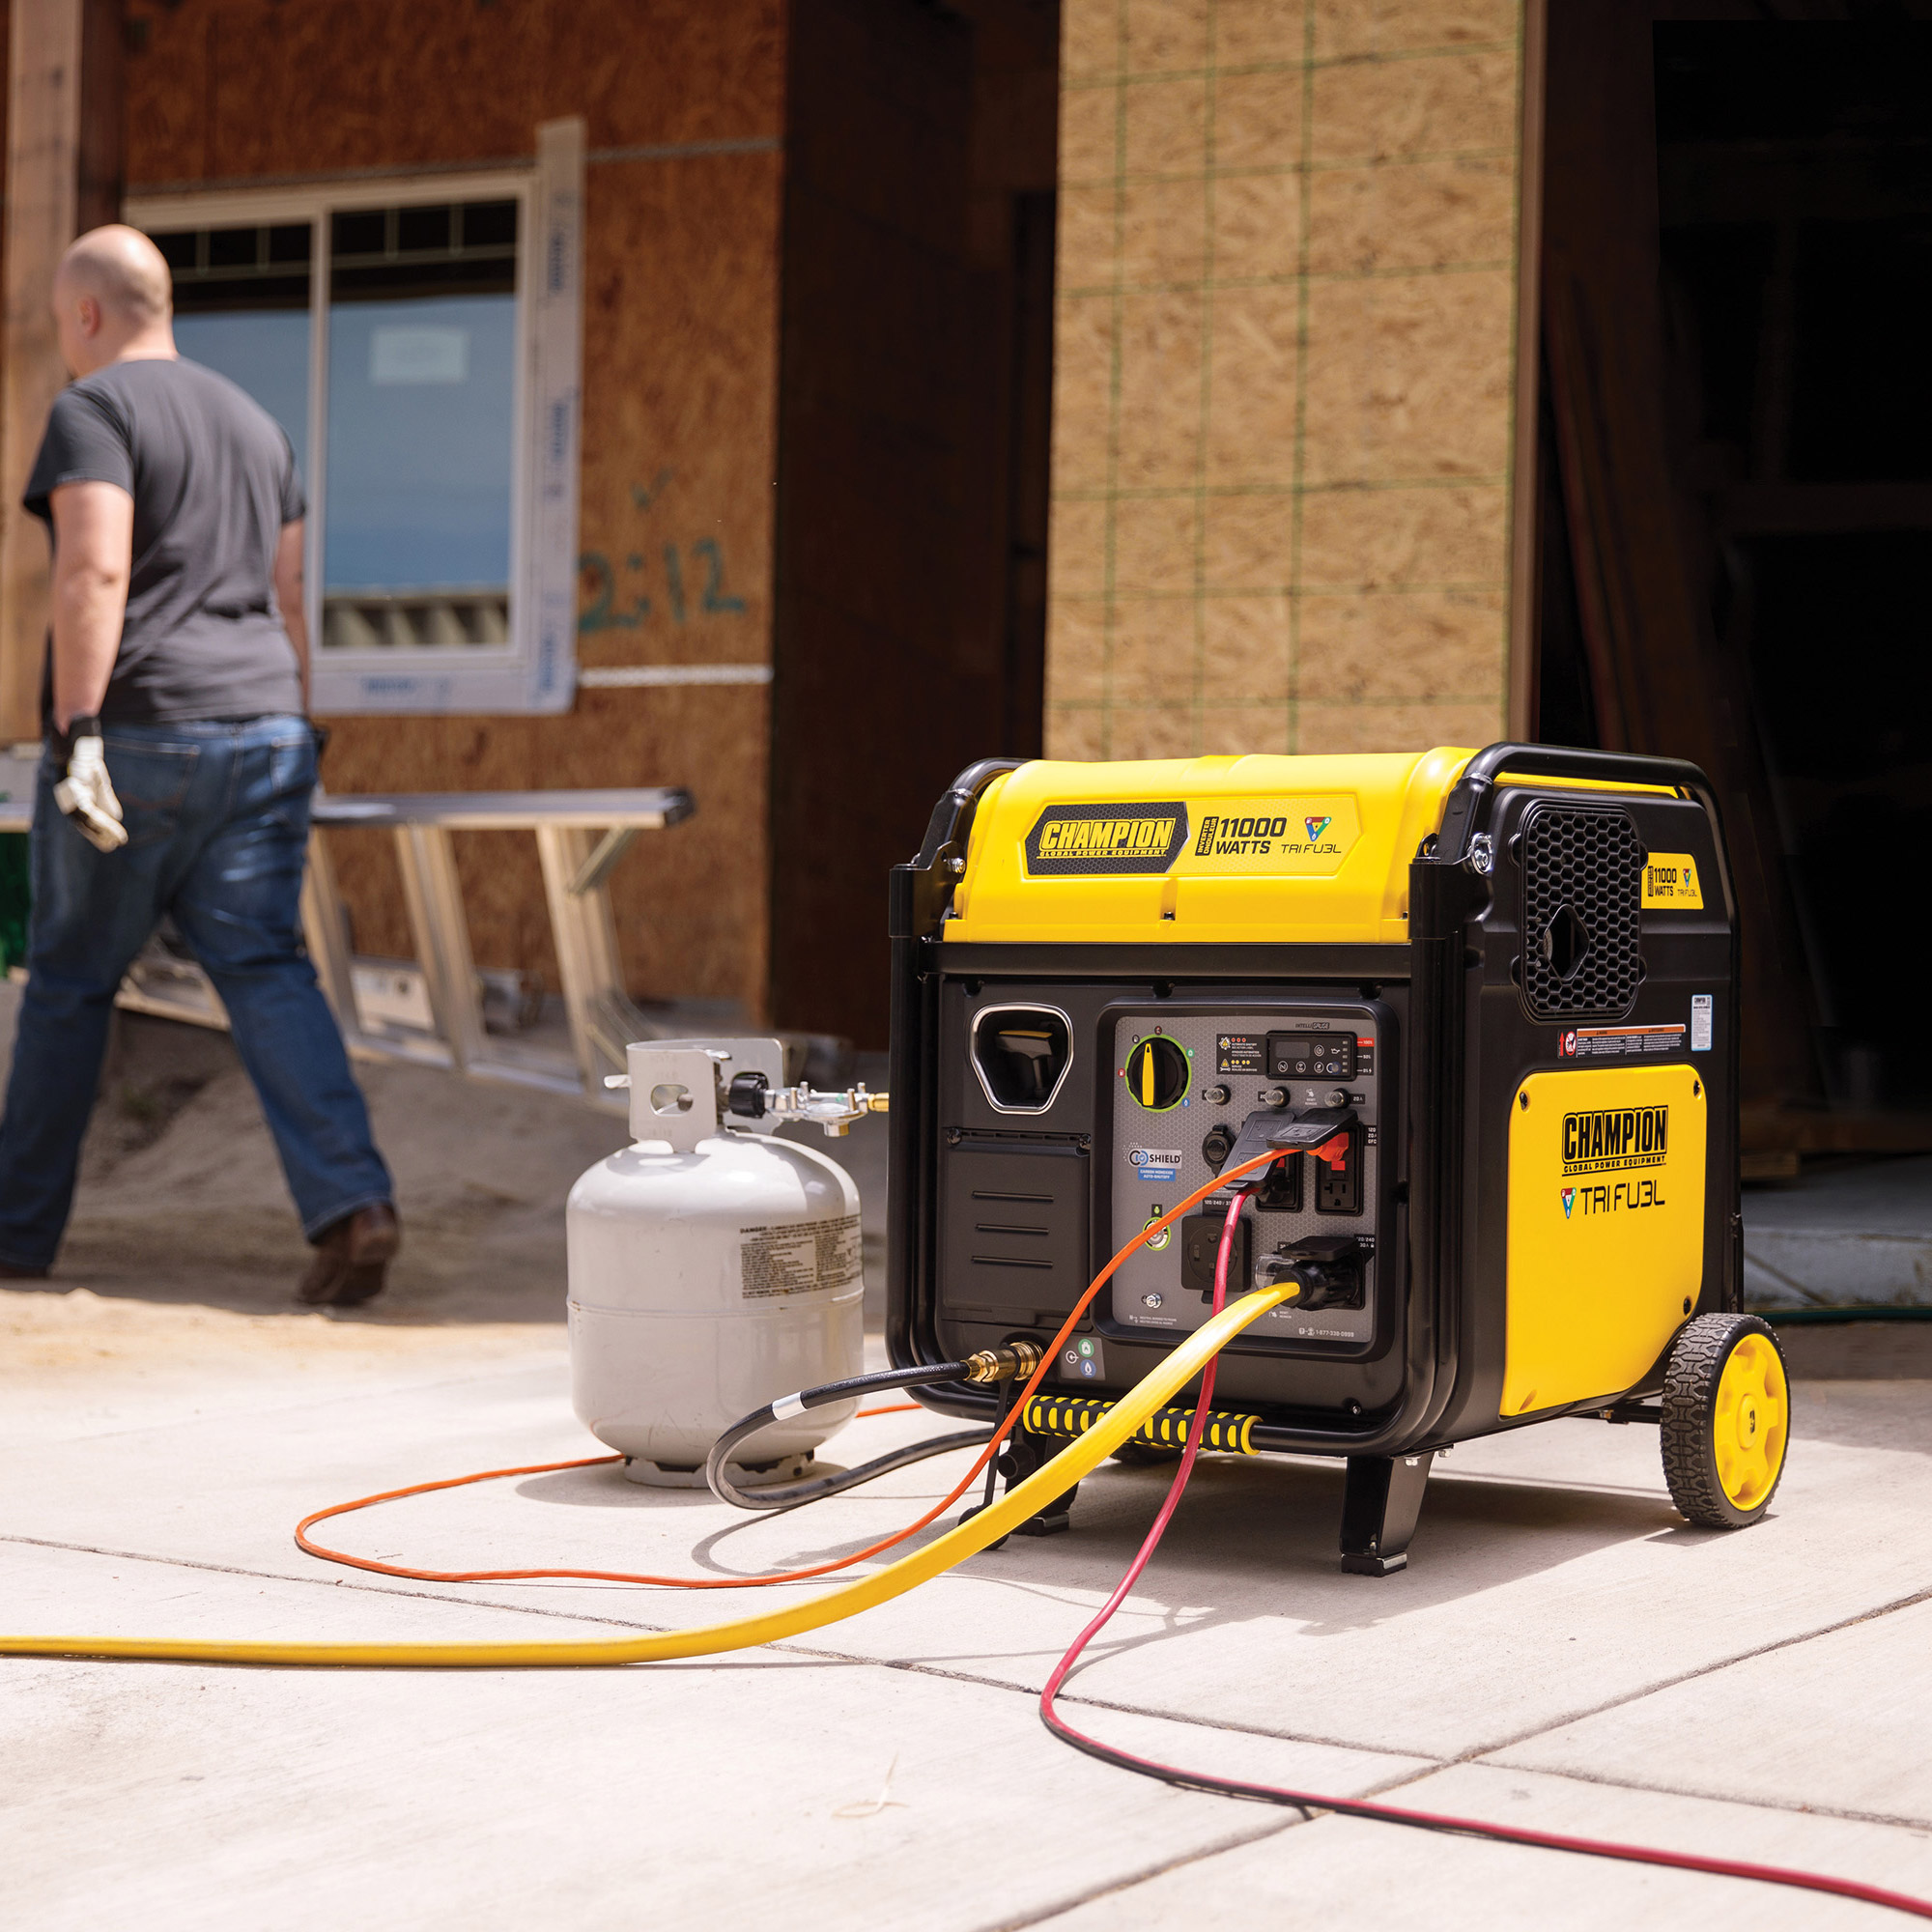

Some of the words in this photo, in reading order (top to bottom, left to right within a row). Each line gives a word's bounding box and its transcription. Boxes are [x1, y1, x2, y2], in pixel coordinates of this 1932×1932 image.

[1039, 818, 1176, 850] CHAMPION
[1197, 819, 1211, 853] INVERTER
[1204, 817, 1218, 855] ONDULEUR
[1220, 817, 1287, 838] 11000
[1216, 840, 1271, 855] WATTS
[1654, 867, 1677, 884] 11000
[1654, 886, 1674, 896] WATTS
[1562, 1105, 1668, 1165] CHAMPION
[1150, 1154, 1180, 1164] SHIELD
[1564, 1164, 1592, 1174] GLOBAL
[1595, 1161, 1621, 1170] POWER
[1624, 1155, 1665, 1166] EQUIPMENT
